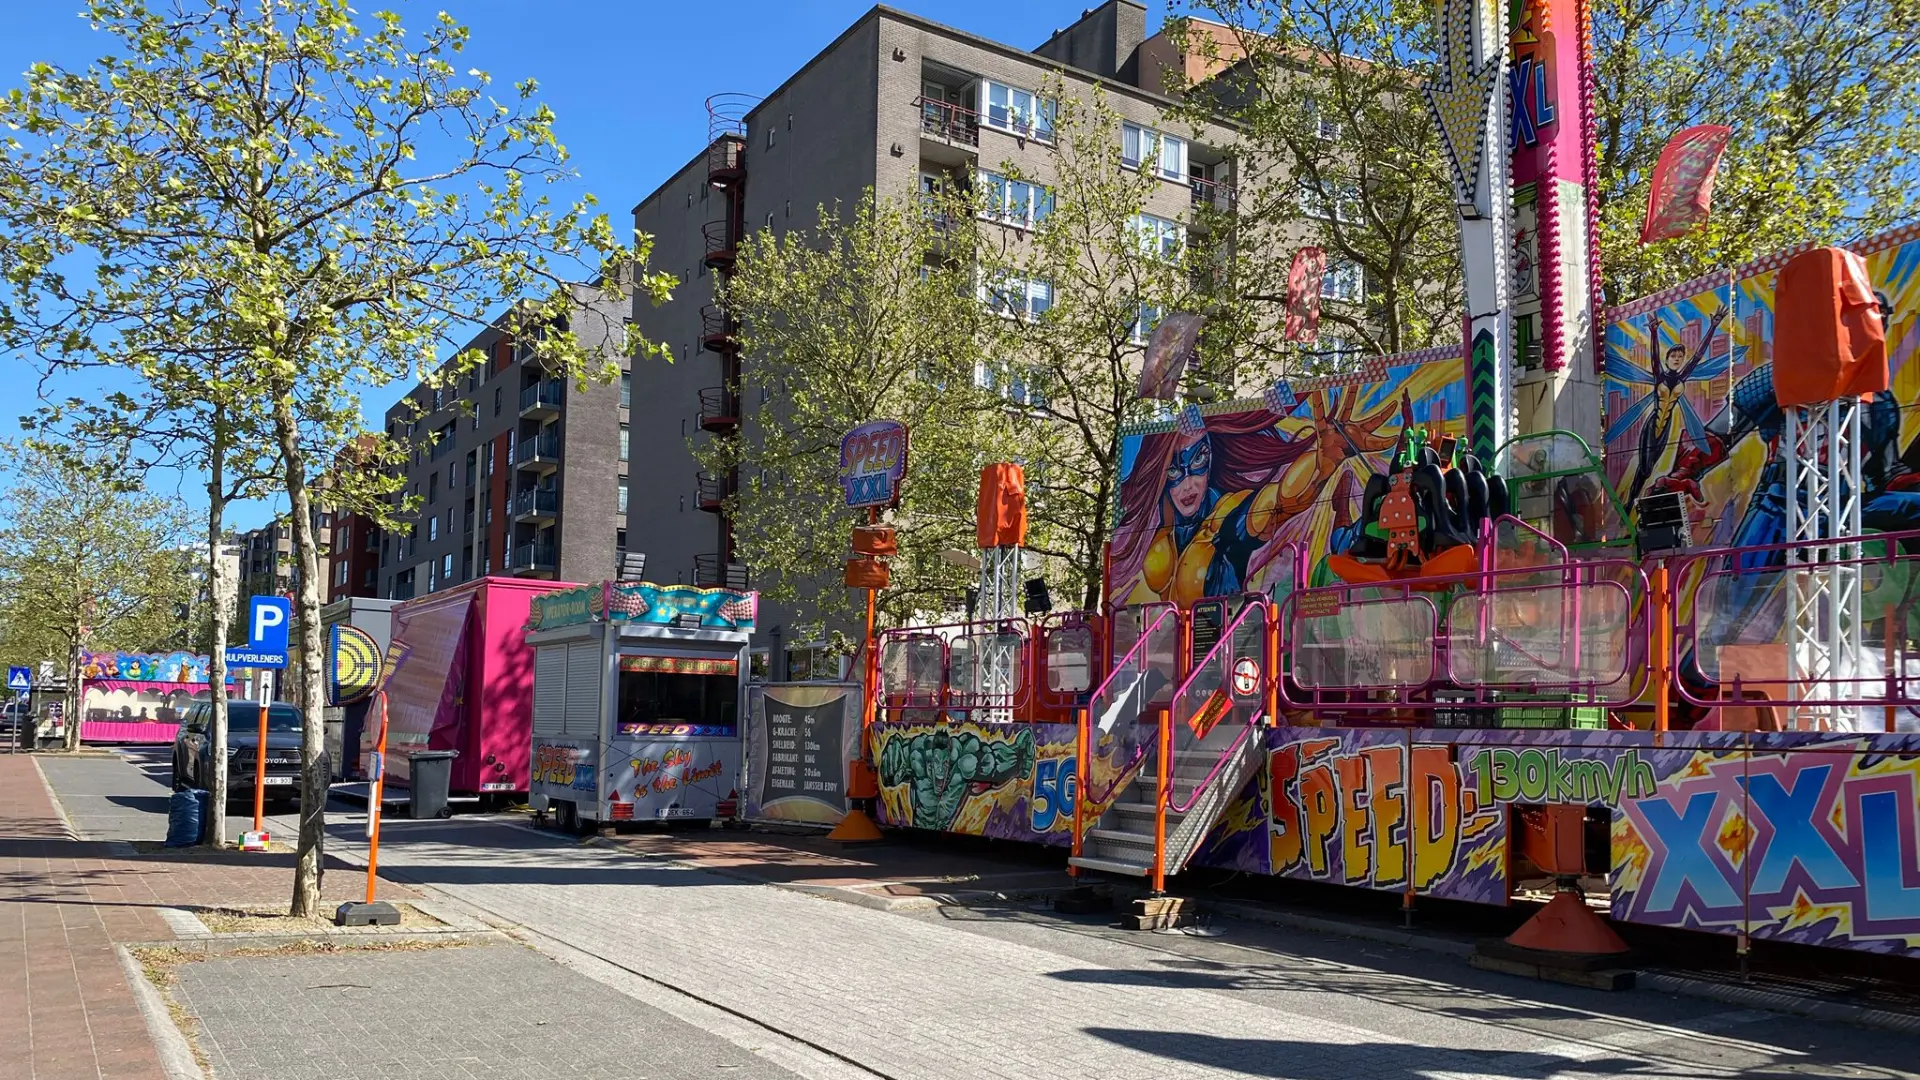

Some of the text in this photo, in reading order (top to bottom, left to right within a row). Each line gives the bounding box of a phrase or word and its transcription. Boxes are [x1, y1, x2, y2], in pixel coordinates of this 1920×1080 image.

[1508, 58, 1554, 150] XL
[840, 427, 903, 477] SPEED
[847, 473, 890, 505] XXL
[254, 604, 284, 641] P
[225, 653, 284, 664] HULPVERLENERS
[621, 724, 731, 736] SPEED XXL
[804, 714, 816, 725] 45m
[532, 743, 578, 787] SPEED
[630, 748, 692, 778] The Sky
[1470, 748, 1657, 808] 130km/h
[634, 783, 648, 798] is
[652, 774, 677, 793] the
[803, 780, 824, 791] JANSSEN
[824, 781, 838, 792] EDDY
[1032, 757, 1077, 832] 5G
[1268, 738, 1463, 893] SPEED
[1628, 750, 1920, 928] XXL
